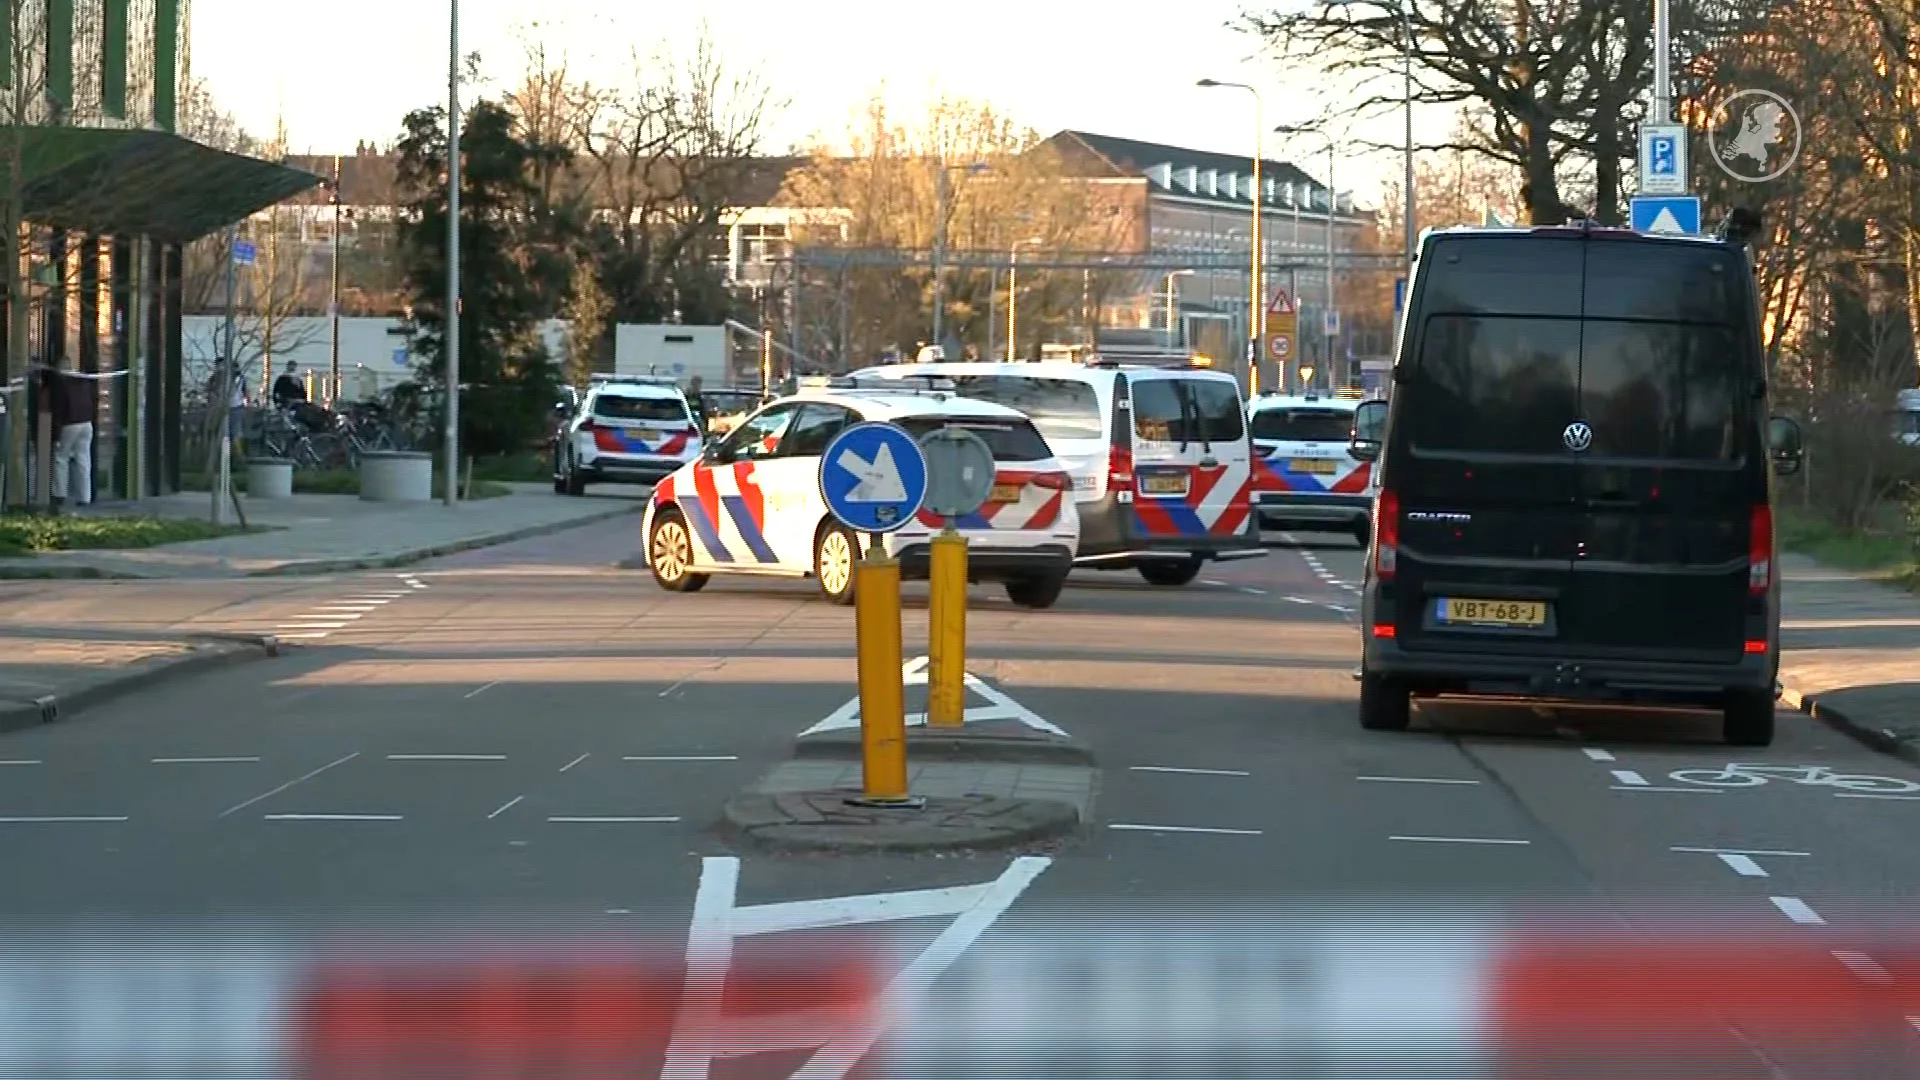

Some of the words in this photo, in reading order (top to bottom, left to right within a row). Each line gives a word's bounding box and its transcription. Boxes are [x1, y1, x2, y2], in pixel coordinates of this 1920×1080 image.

[1655, 140, 1671, 159] P
[1407, 512, 1472, 522] CRAFTER
[1452, 601, 1536, 621] VBT-68-J
